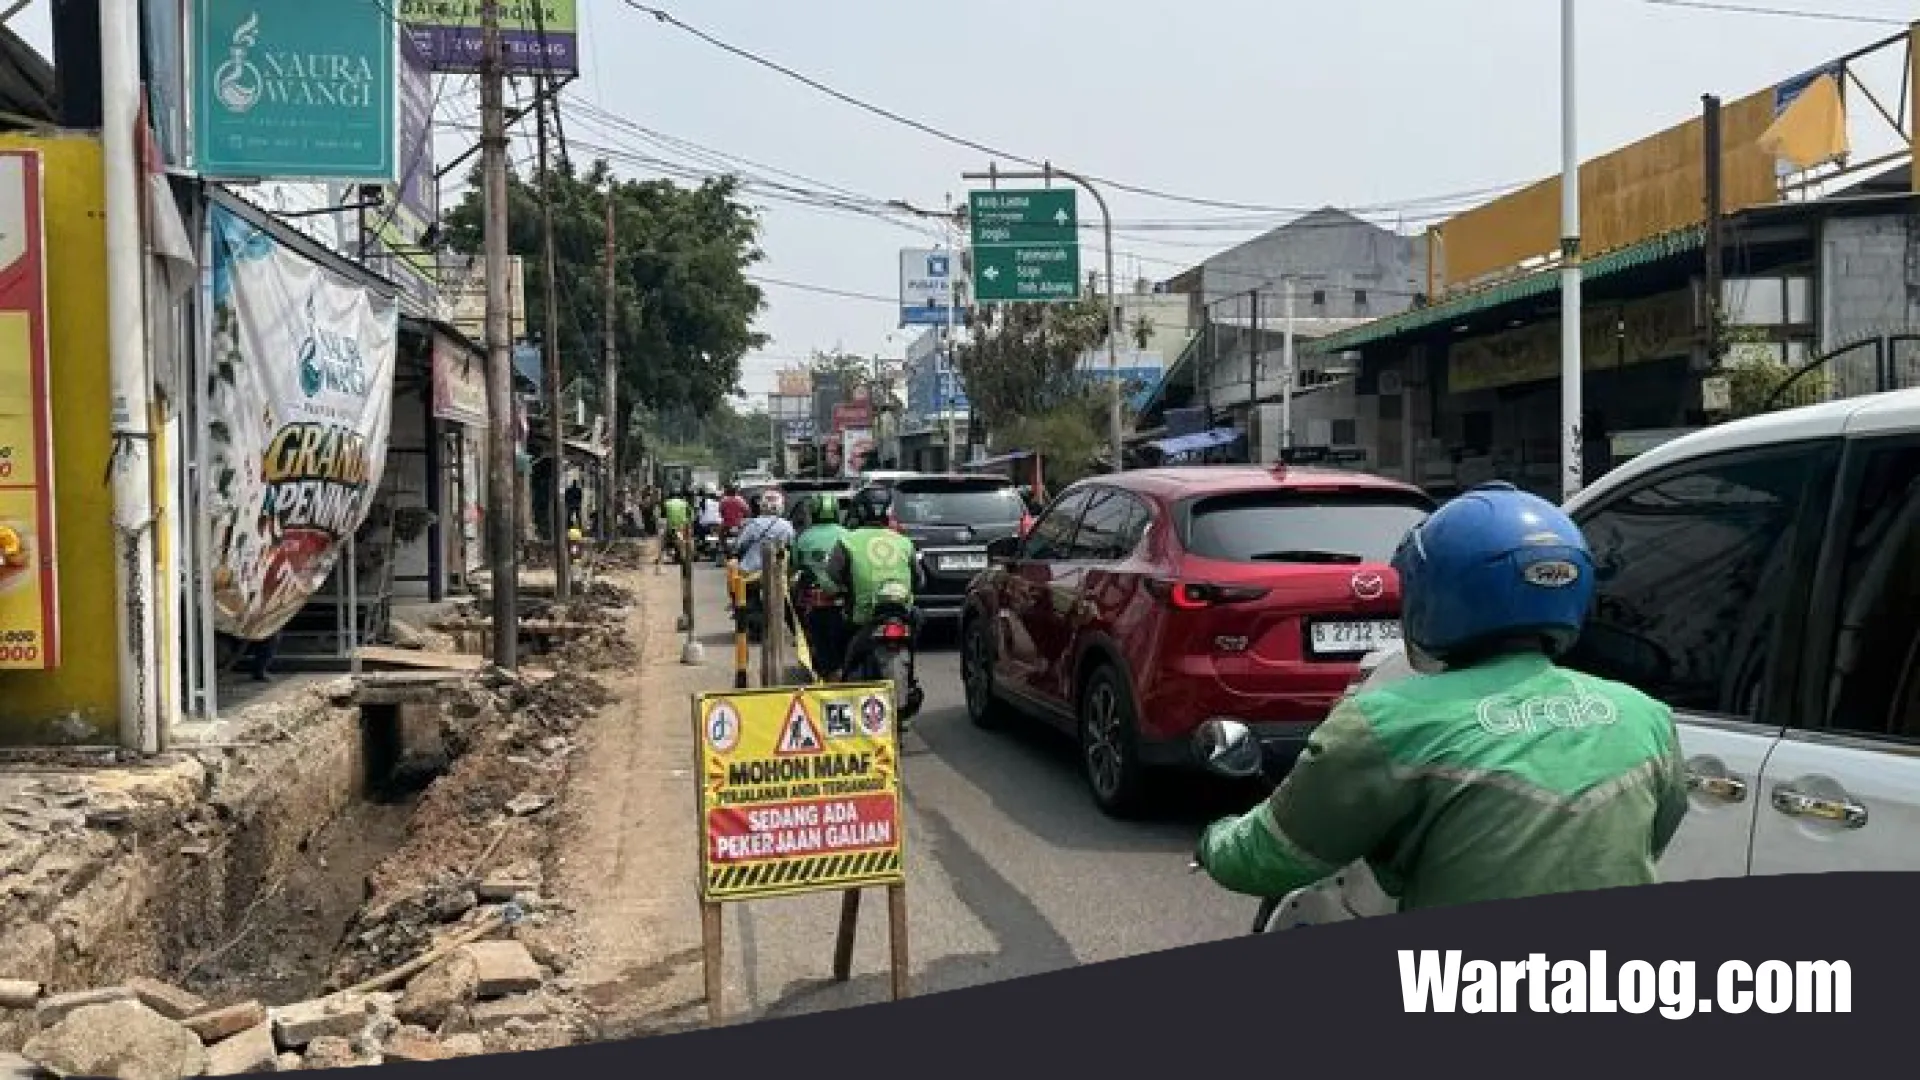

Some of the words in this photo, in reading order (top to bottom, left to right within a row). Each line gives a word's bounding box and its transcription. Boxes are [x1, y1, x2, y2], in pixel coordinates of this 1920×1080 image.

[264, 51, 374, 82] NAURA
[262, 80, 371, 107] WANGI
[1315, 624, 1326, 642] B
[1477, 687, 1616, 735] Grab
[729, 759, 809, 785] MOHON
[814, 753, 871, 779] MAAF
[748, 804, 819, 831] SEDANG
[823, 801, 858, 823] ADA
[717, 827, 821, 859] PEKERJAAN
[825, 820, 890, 848] GALIAN
